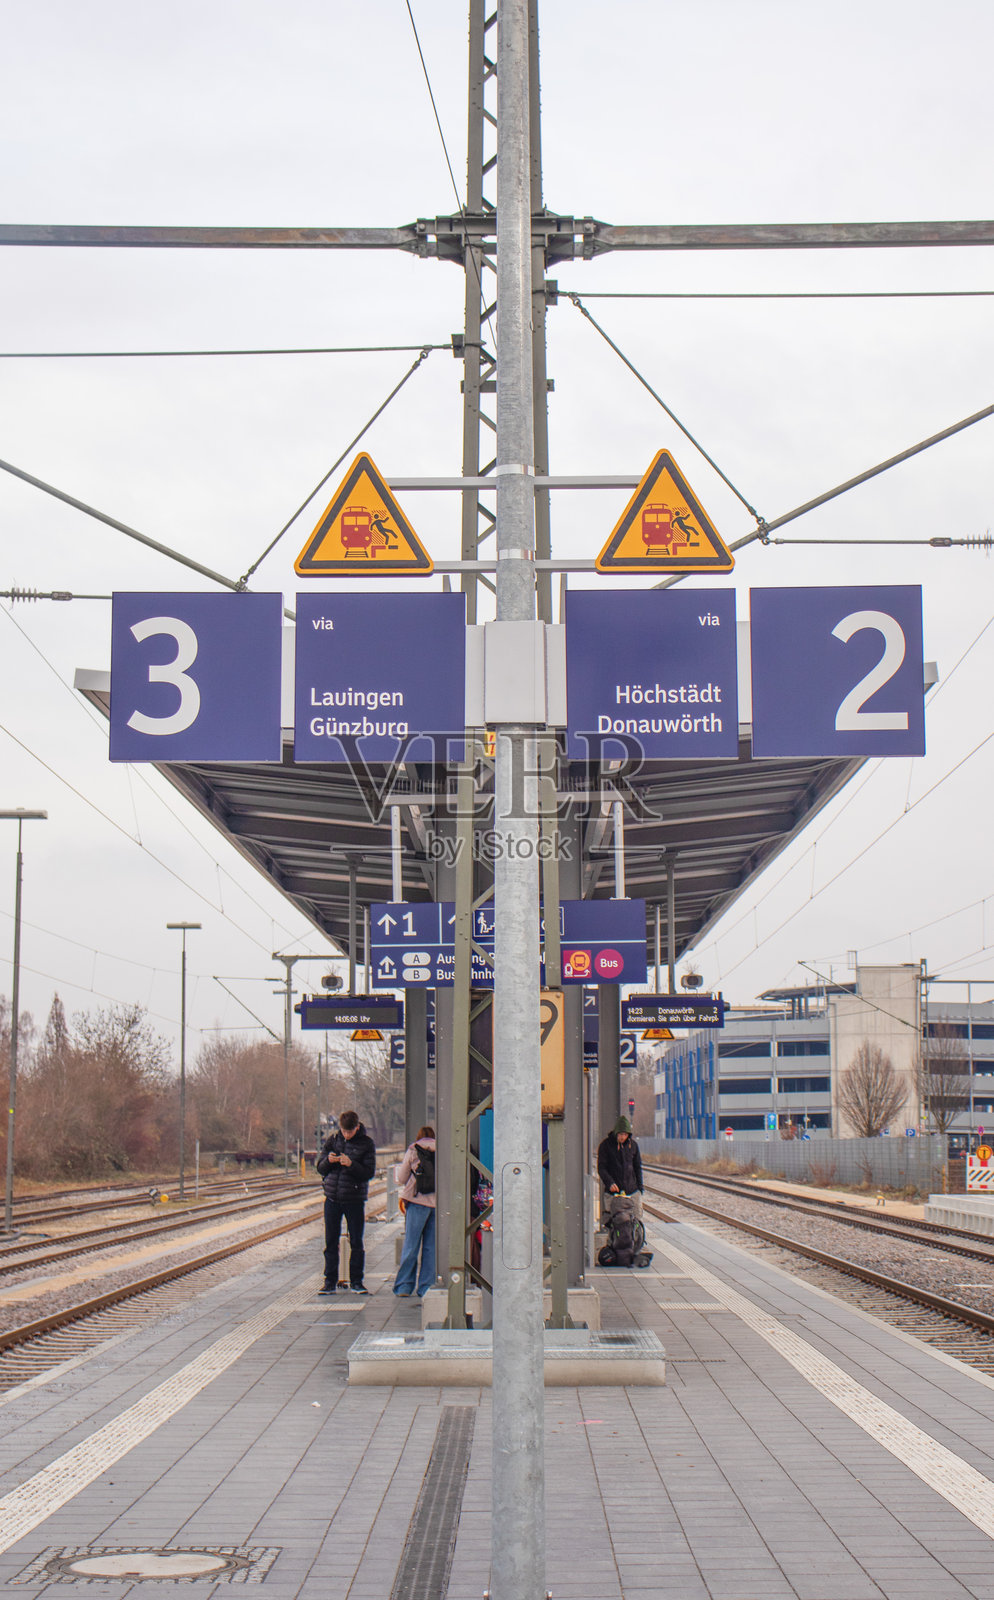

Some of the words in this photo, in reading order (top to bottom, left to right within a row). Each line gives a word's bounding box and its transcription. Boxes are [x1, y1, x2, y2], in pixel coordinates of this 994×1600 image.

[312, 617, 334, 630] via
[698, 613, 720, 626] via
[126, 616, 201, 736] 3
[831, 610, 909, 731] 2
[310, 688, 404, 710] Lauingen
[615, 684, 722, 704] Höchstädt
[310, 717, 409, 741] Günzburg
[597, 713, 723, 734] Donauwörth
[402, 911, 417, 937] 1
[412, 955, 421, 964] A
[436, 953, 486, 966] Ausng
[600, 958, 618, 968] Bus
[412, 970, 421, 979] B
[658, 1006, 694, 1014] Donauwörth
[713, 1006, 718, 1014] 2
[393, 1039, 405, 1065] 3
[620, 1038, 635, 1064] 2
